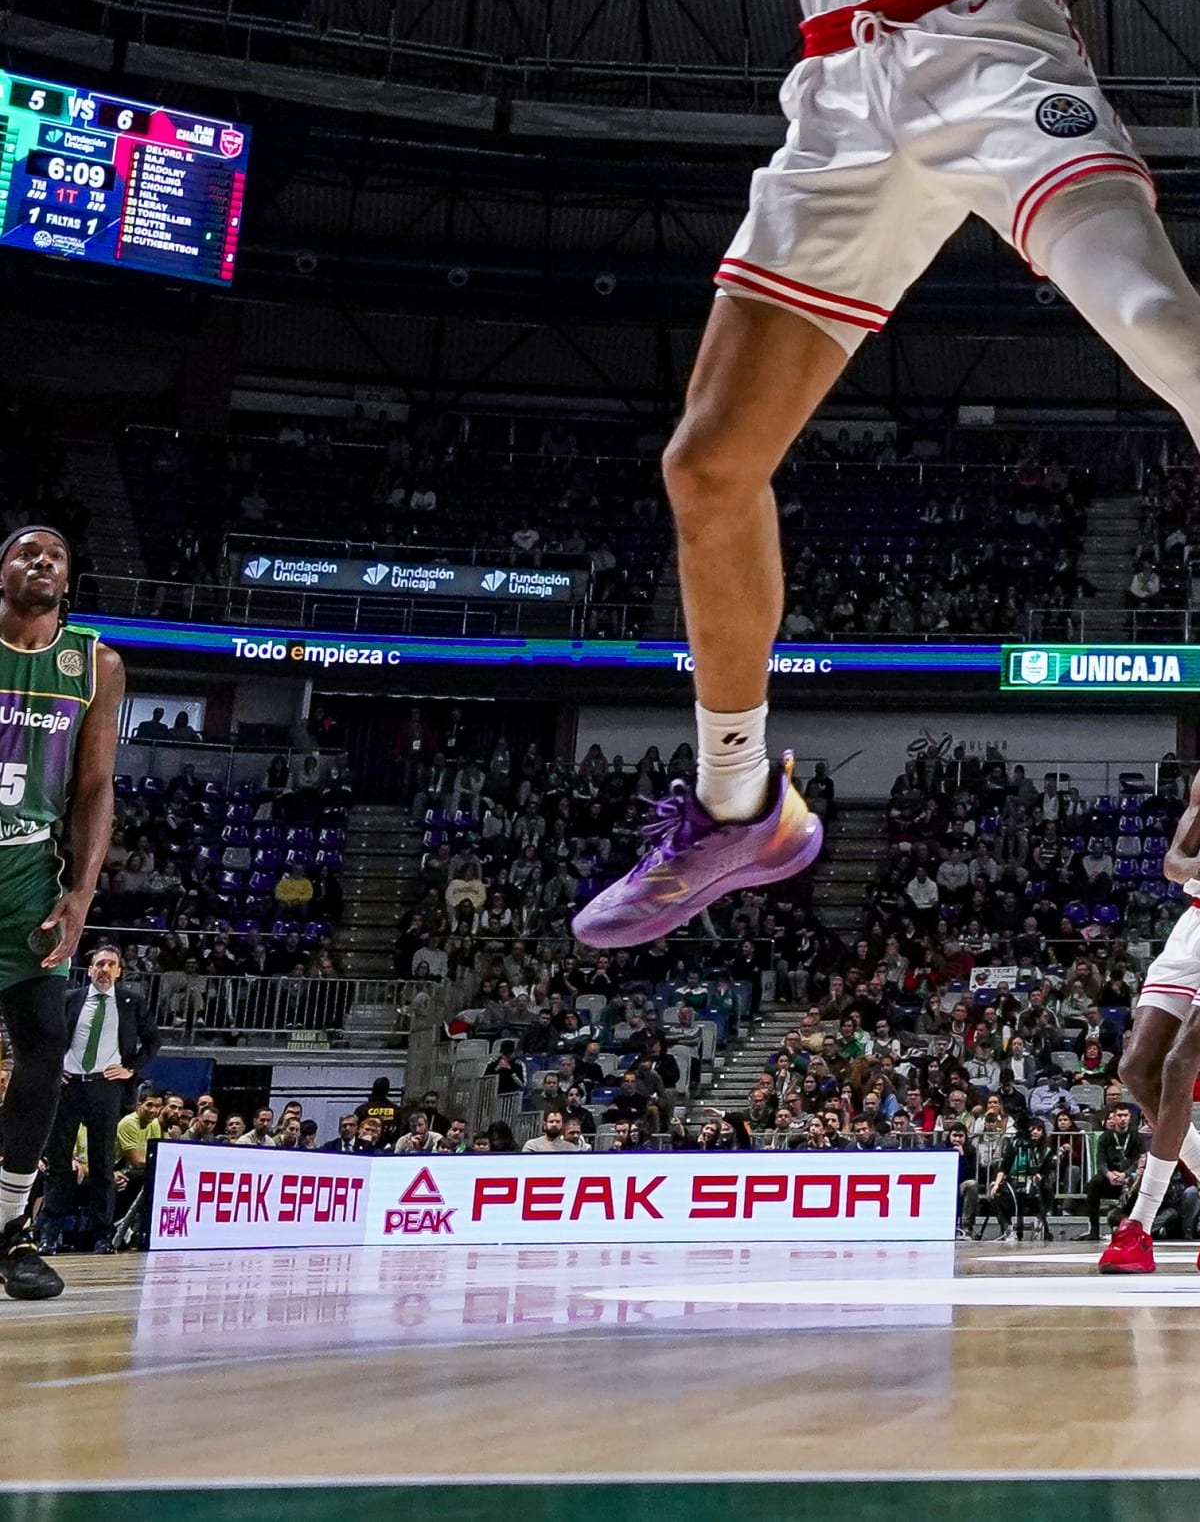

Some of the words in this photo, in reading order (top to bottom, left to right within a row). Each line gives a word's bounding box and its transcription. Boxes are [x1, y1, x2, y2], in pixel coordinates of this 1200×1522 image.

[28, 90, 47, 110] 5
[68, 96, 96, 121] VS
[117, 110, 134, 130] 6
[48, 157, 105, 188] 6:09
[31, 179, 47, 191] TM
[56, 188, 78, 204] 1T
[90, 191, 105, 203] TM
[28, 207, 40, 224] 1
[45, 213, 81, 230] FALTAS
[86, 218, 98, 235] 1
[274, 559, 338, 574] Fundación
[391, 565, 454, 580] Fundación
[273, 570, 319, 586] Unicaja
[391, 577, 436, 592] Unicaja
[509, 572, 570, 586] Fundación
[508, 583, 552, 597] Unicaja
[232, 638, 287, 659] Todo
[290, 644, 383, 668] empieza
[1070, 654, 1181, 682] UNICAJA
[195, 1171, 273, 1222] PEAK
[278, 1175, 364, 1222] SPORT
[471, 1175, 668, 1222] PEAK
[688, 1174, 937, 1219] SPORT
[159, 1206, 191, 1237] PEAK
[383, 1208, 459, 1235] PEAK
